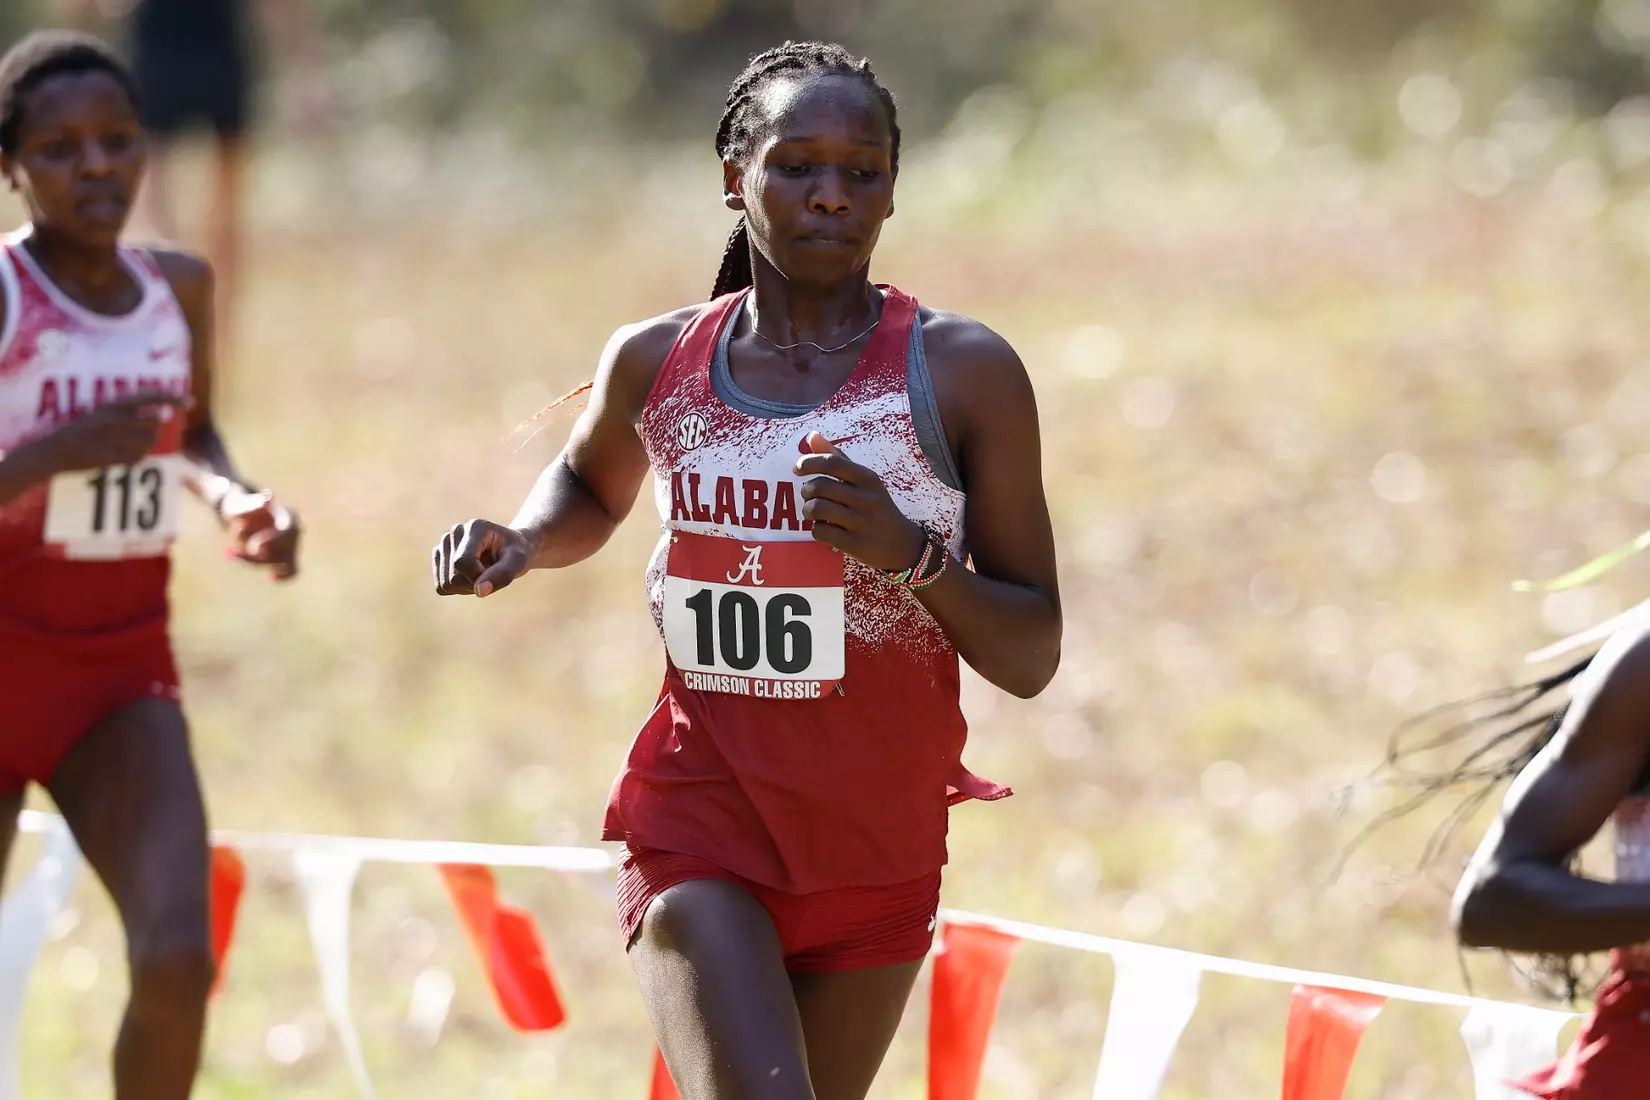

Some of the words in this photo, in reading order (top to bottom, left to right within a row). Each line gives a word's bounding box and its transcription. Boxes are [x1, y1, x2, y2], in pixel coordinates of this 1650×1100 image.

[680, 413, 706, 450] SEC
[87, 466, 162, 533] 113
[671, 471, 814, 532] ALABA
[726, 545, 765, 585] A
[685, 589, 812, 674] 106
[684, 672, 750, 696] CRIMSON
[754, 678, 821, 699] CLASSIC
